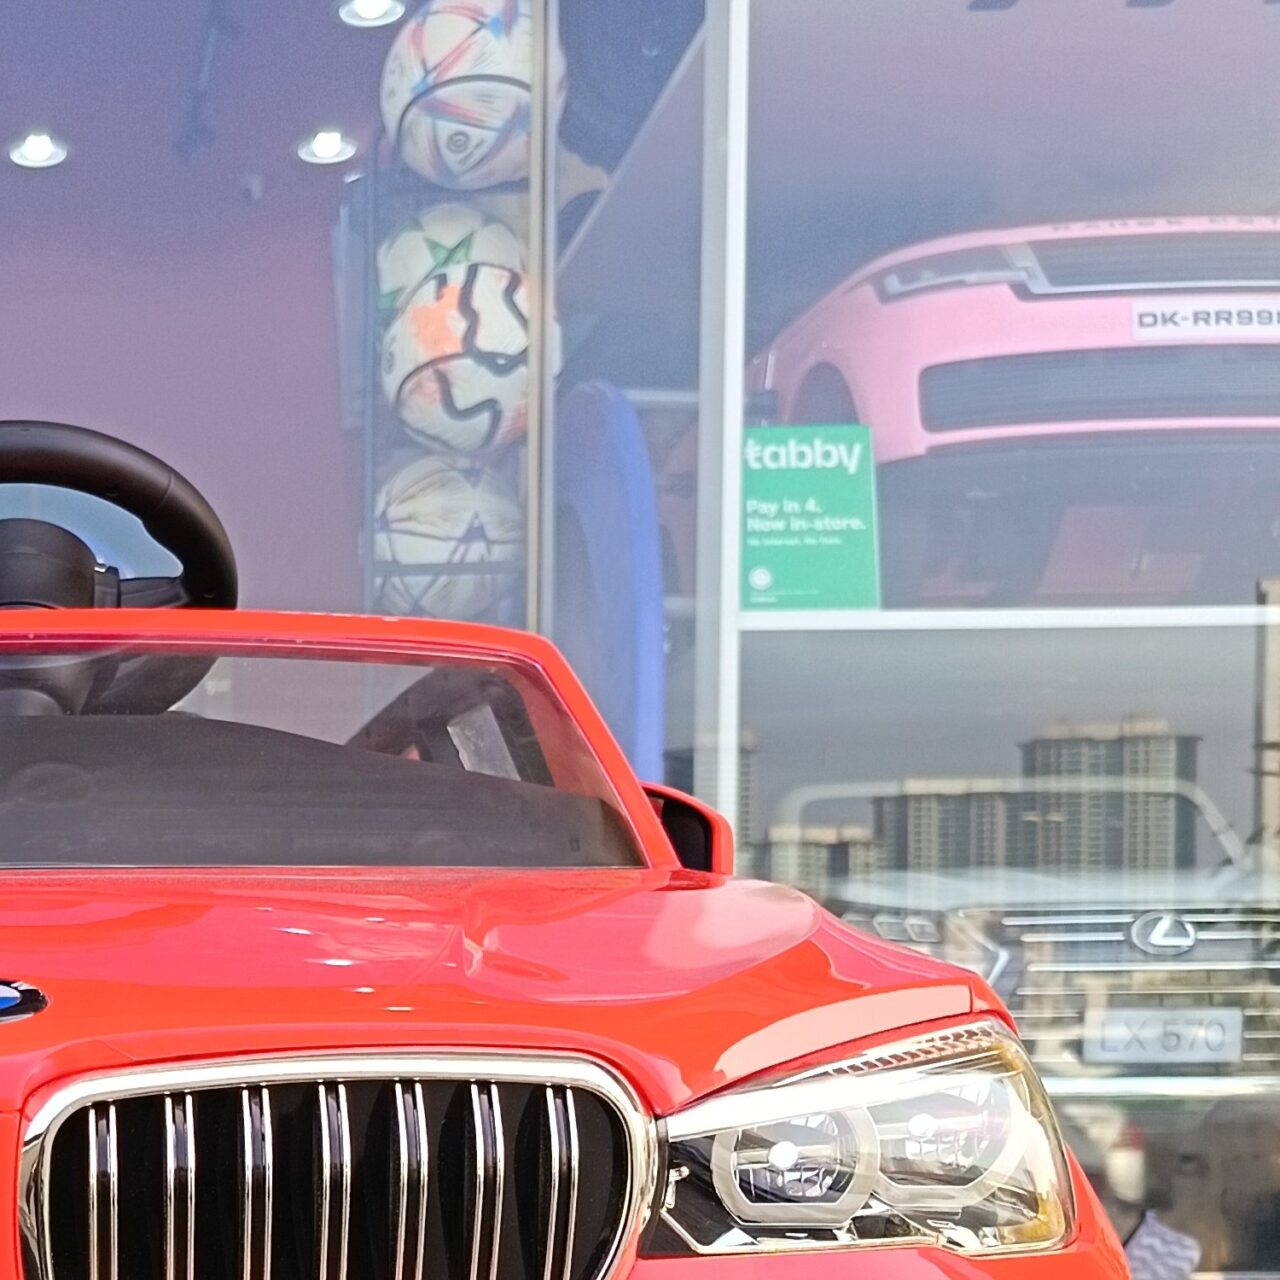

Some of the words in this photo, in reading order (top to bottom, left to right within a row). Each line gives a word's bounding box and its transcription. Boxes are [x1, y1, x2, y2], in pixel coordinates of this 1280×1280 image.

[1137, 310, 1280, 328] DK-RR99
[745, 438, 862, 475] tabby
[746, 499, 779, 517] Pay
[783, 498, 800, 514] in
[805, 497, 823, 513] 4.
[746, 518, 785, 531] Now
[790, 516, 866, 531] in-store.
[1101, 1020, 1146, 1052] LX
[1161, 1018, 1226, 1052] 570
